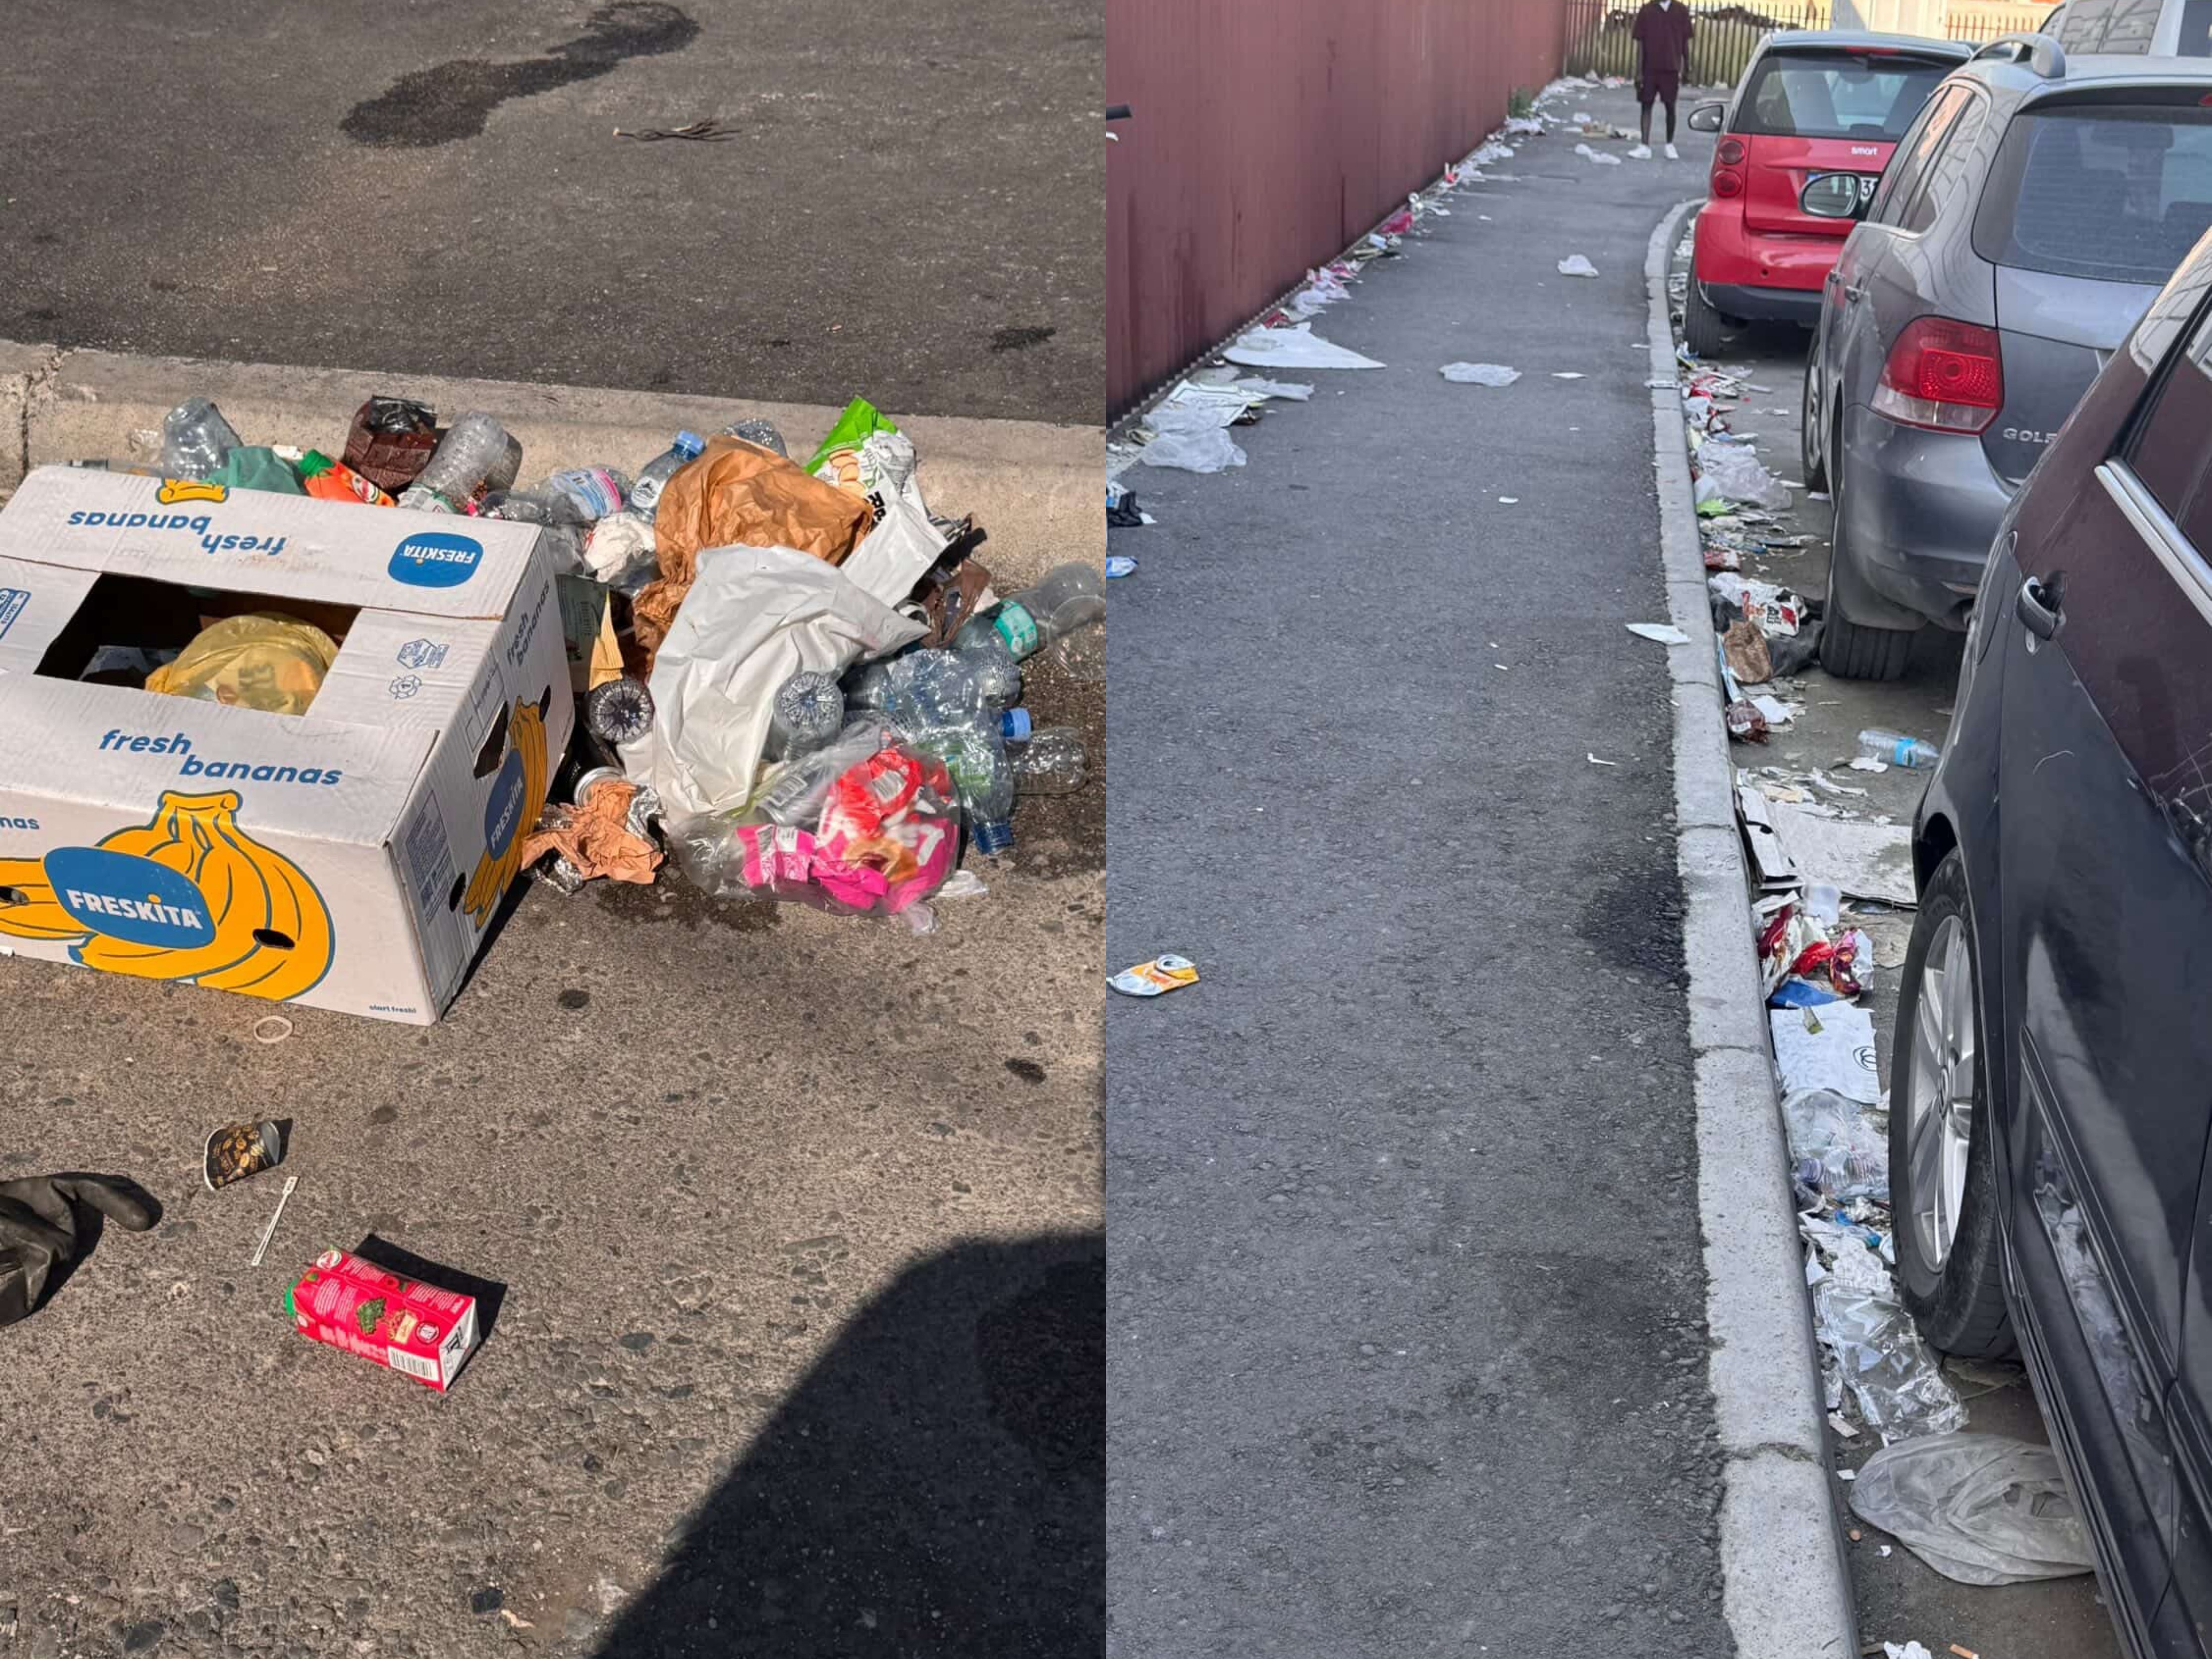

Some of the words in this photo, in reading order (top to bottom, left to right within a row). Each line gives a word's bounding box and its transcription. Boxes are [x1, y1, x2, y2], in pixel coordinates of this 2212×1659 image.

[1851, 146, 1877, 155] smart
[2003, 428, 2058, 443] GOLF
[68, 512, 211, 534] bananas
[202, 535, 286, 555] fresh
[517, 578, 550, 666] bananas
[507, 611, 528, 665] fresh
[99, 729, 193, 755] fresh
[179, 754, 343, 785] bananas
